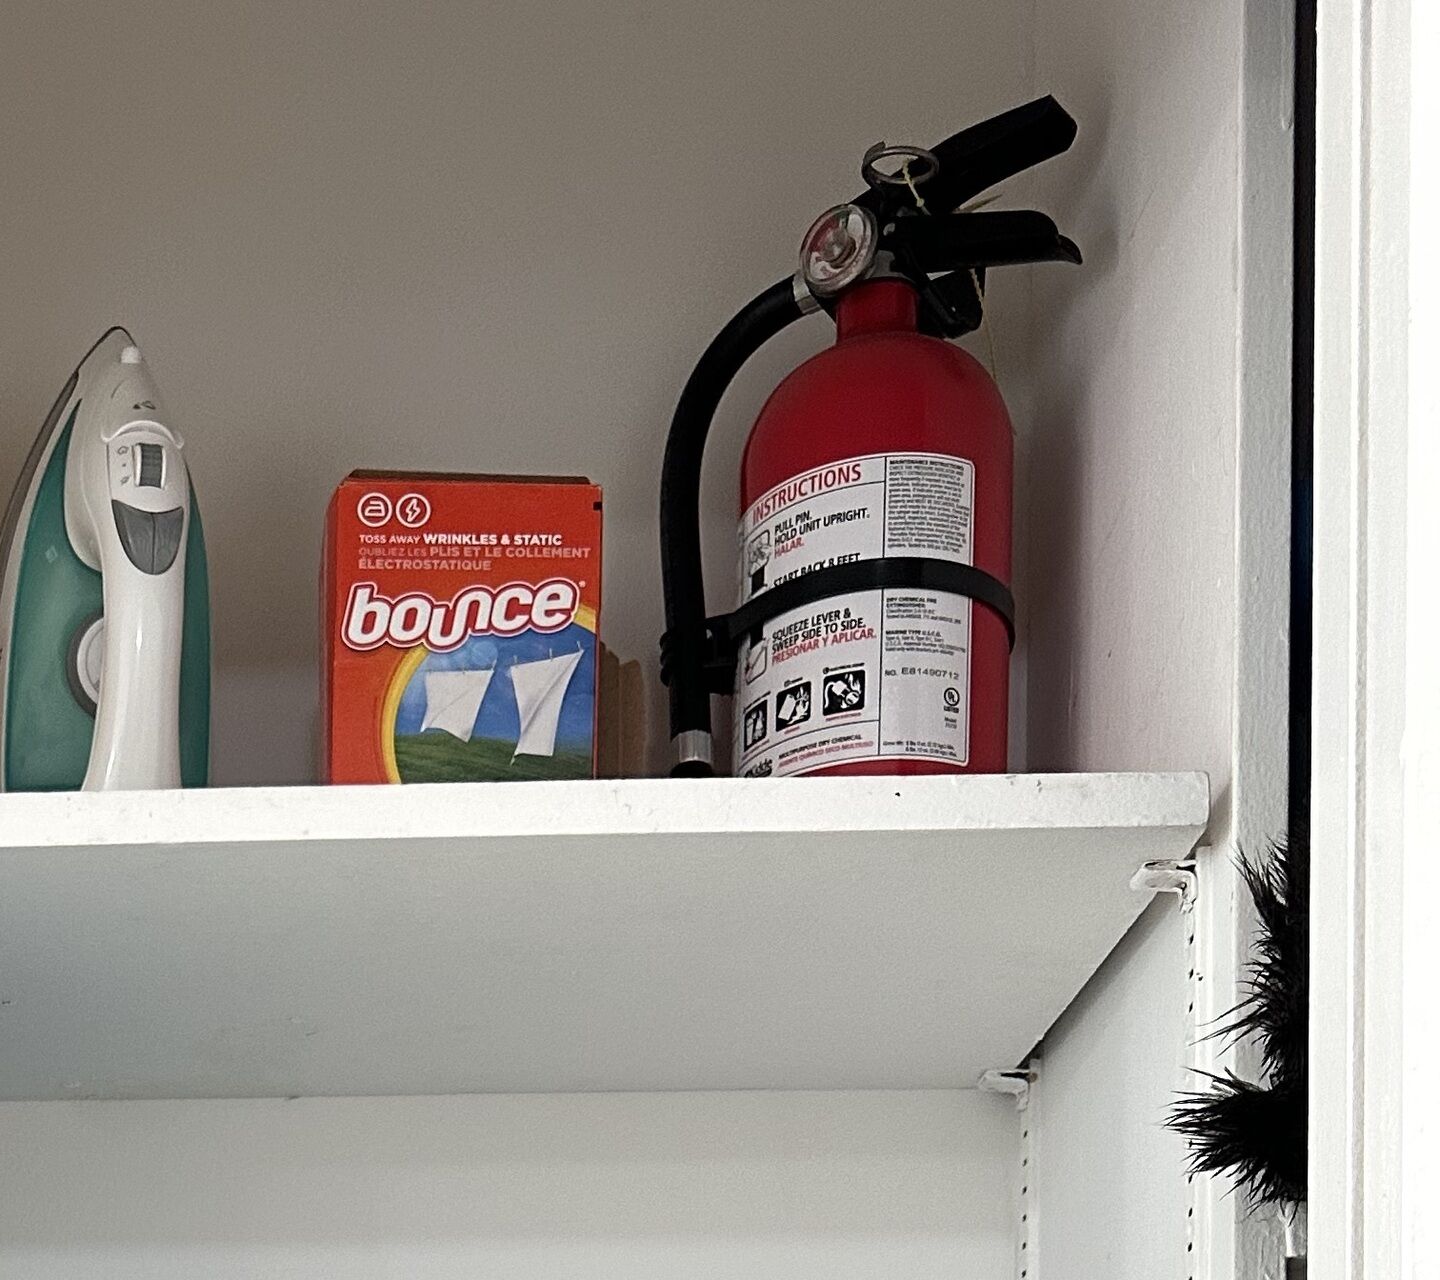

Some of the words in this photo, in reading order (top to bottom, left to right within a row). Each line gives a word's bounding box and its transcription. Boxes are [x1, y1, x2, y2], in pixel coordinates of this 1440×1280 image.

[753, 463, 861, 525] INSTRUCTIONS
[359, 534, 387, 544] TOSS
[389, 535, 421, 544] AWAY
[423, 533, 497, 545] WRINKLES
[500, 534, 511, 545] &
[514, 534, 563, 546] STATIC
[774, 518, 793, 535] PULL
[795, 510, 812, 524] PIN.
[774, 528, 797, 546] HOLD
[799, 519, 821, 535] UNIT
[823, 507, 870, 528] UPRIGHT.
[358, 557, 492, 571] ÉLECTROSTATIQUE
[359, 547, 406, 557] OUBLIEZ
[407, 548, 427, 557] LES
[429, 547, 460, 557] PLIS
[463, 547, 480, 557] ET
[485, 547, 502, 558] LE
[505, 547, 592, 559] COLLEMENT
[774, 537, 804, 559] HALAR.
[344, 578, 580, 652] bounce
[772, 618, 809, 643] SQUEEZE
[811, 609, 841, 626] LEVER
[843, 608, 851, 619] &
[772, 634, 799, 654] SWEEP
[802, 628, 823, 644] SIDE
[825, 624, 838, 635] TO
[841, 617, 866, 631] SIDE.
[772, 640, 820, 666] PRESIONAR
[823, 637, 829, 648] Y
[831, 628, 877, 646] APLICAR.
